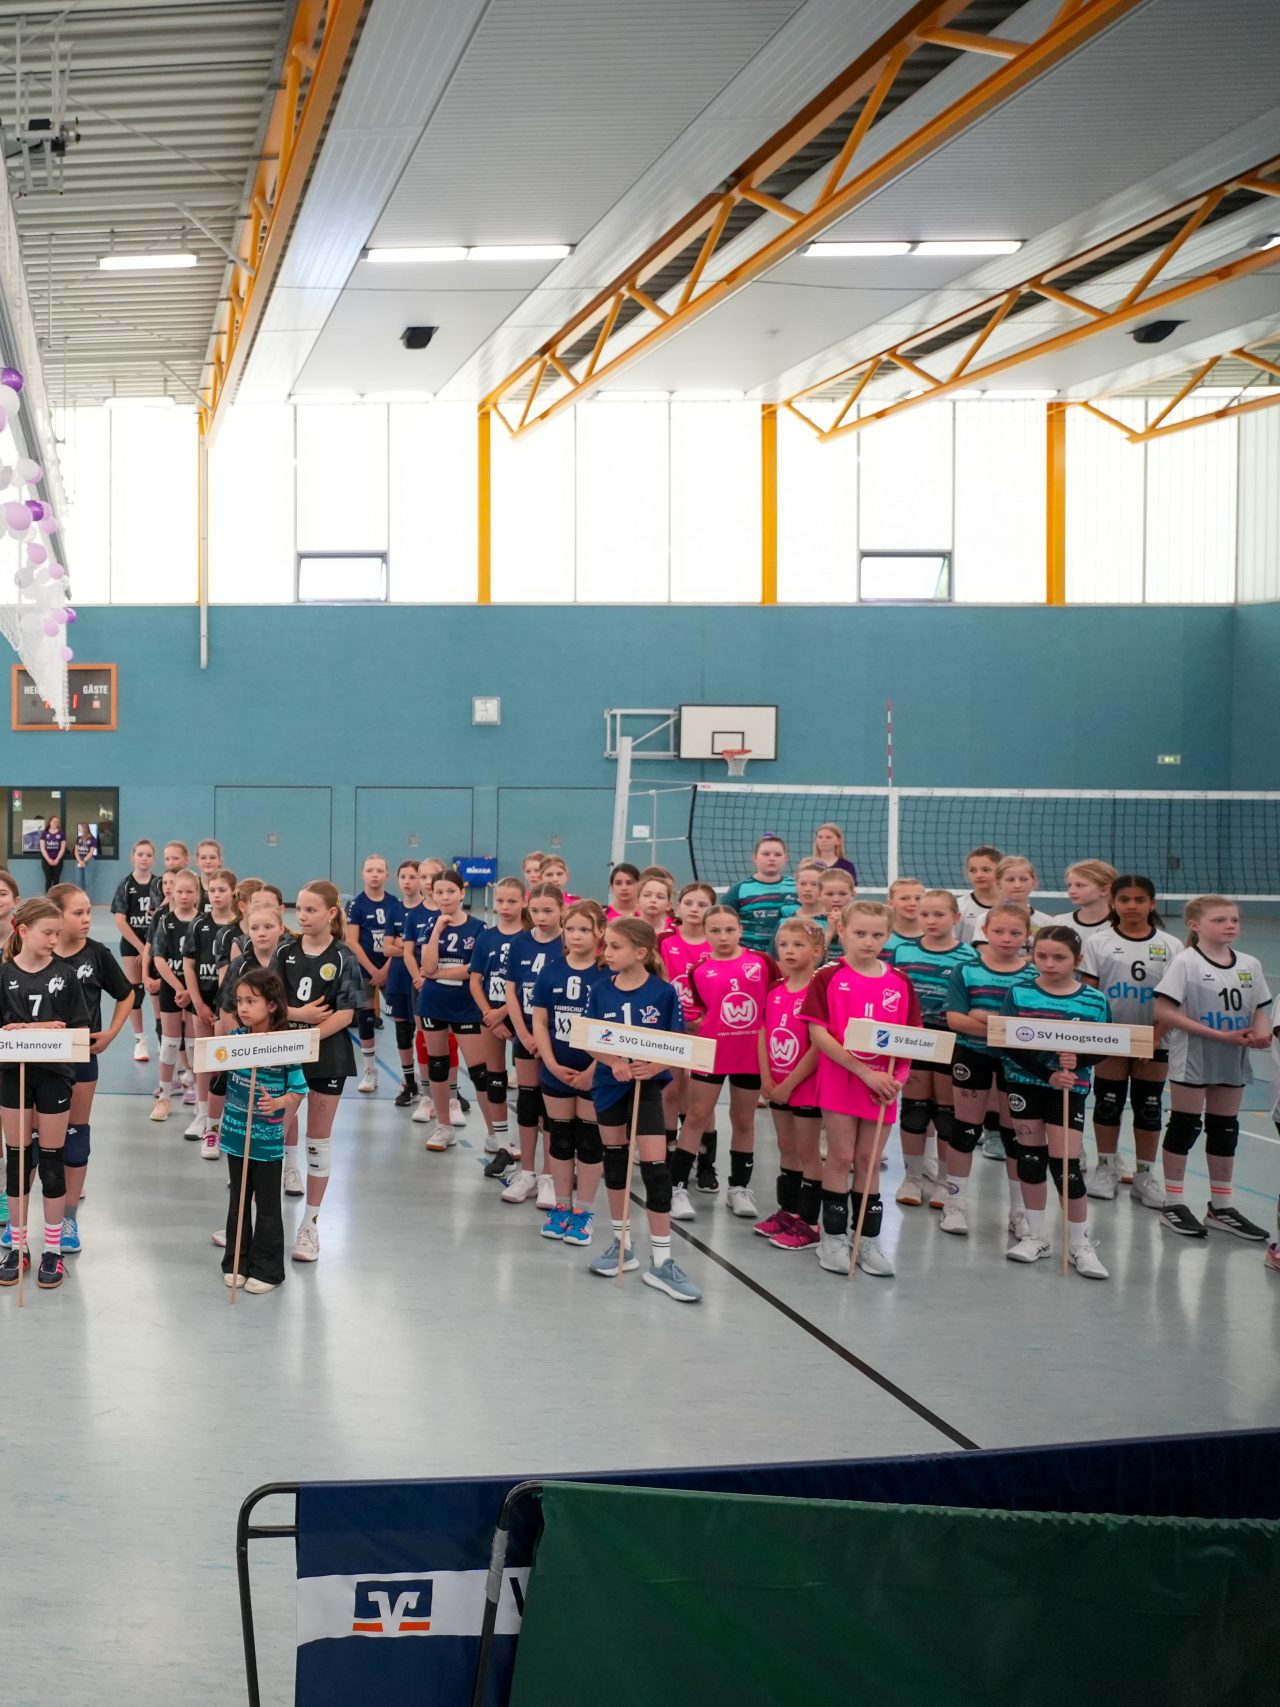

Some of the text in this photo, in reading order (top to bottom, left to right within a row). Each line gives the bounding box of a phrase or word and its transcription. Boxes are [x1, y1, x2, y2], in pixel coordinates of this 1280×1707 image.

[82, 684, 109, 695] GÄSTE
[138, 896, 151, 911] 12
[376, 908, 386, 924] 8
[447, 933, 459, 952] 2
[531, 953, 546, 975] 4
[1131, 960, 1146, 981] 6
[296, 976, 313, 1001] 8
[566, 975, 581, 1000] 6
[730, 978, 739, 992] 3
[28, 995, 43, 1017] 7
[1219, 987, 1242, 1012] 10
[621, 1002, 632, 1026] 1
[864, 1003, 874, 1017] 11
[16, 1041, 62, 1049] Hannover
[619, 1035, 638, 1045] SVG
[640, 1038, 685, 1055] Lüneburg
[894, 1035, 934, 1048] SV Bad Laer
[1037, 1031, 1119, 1044] SV Hoogstede
[231, 1043, 304, 1058] SCU Emlichheim
